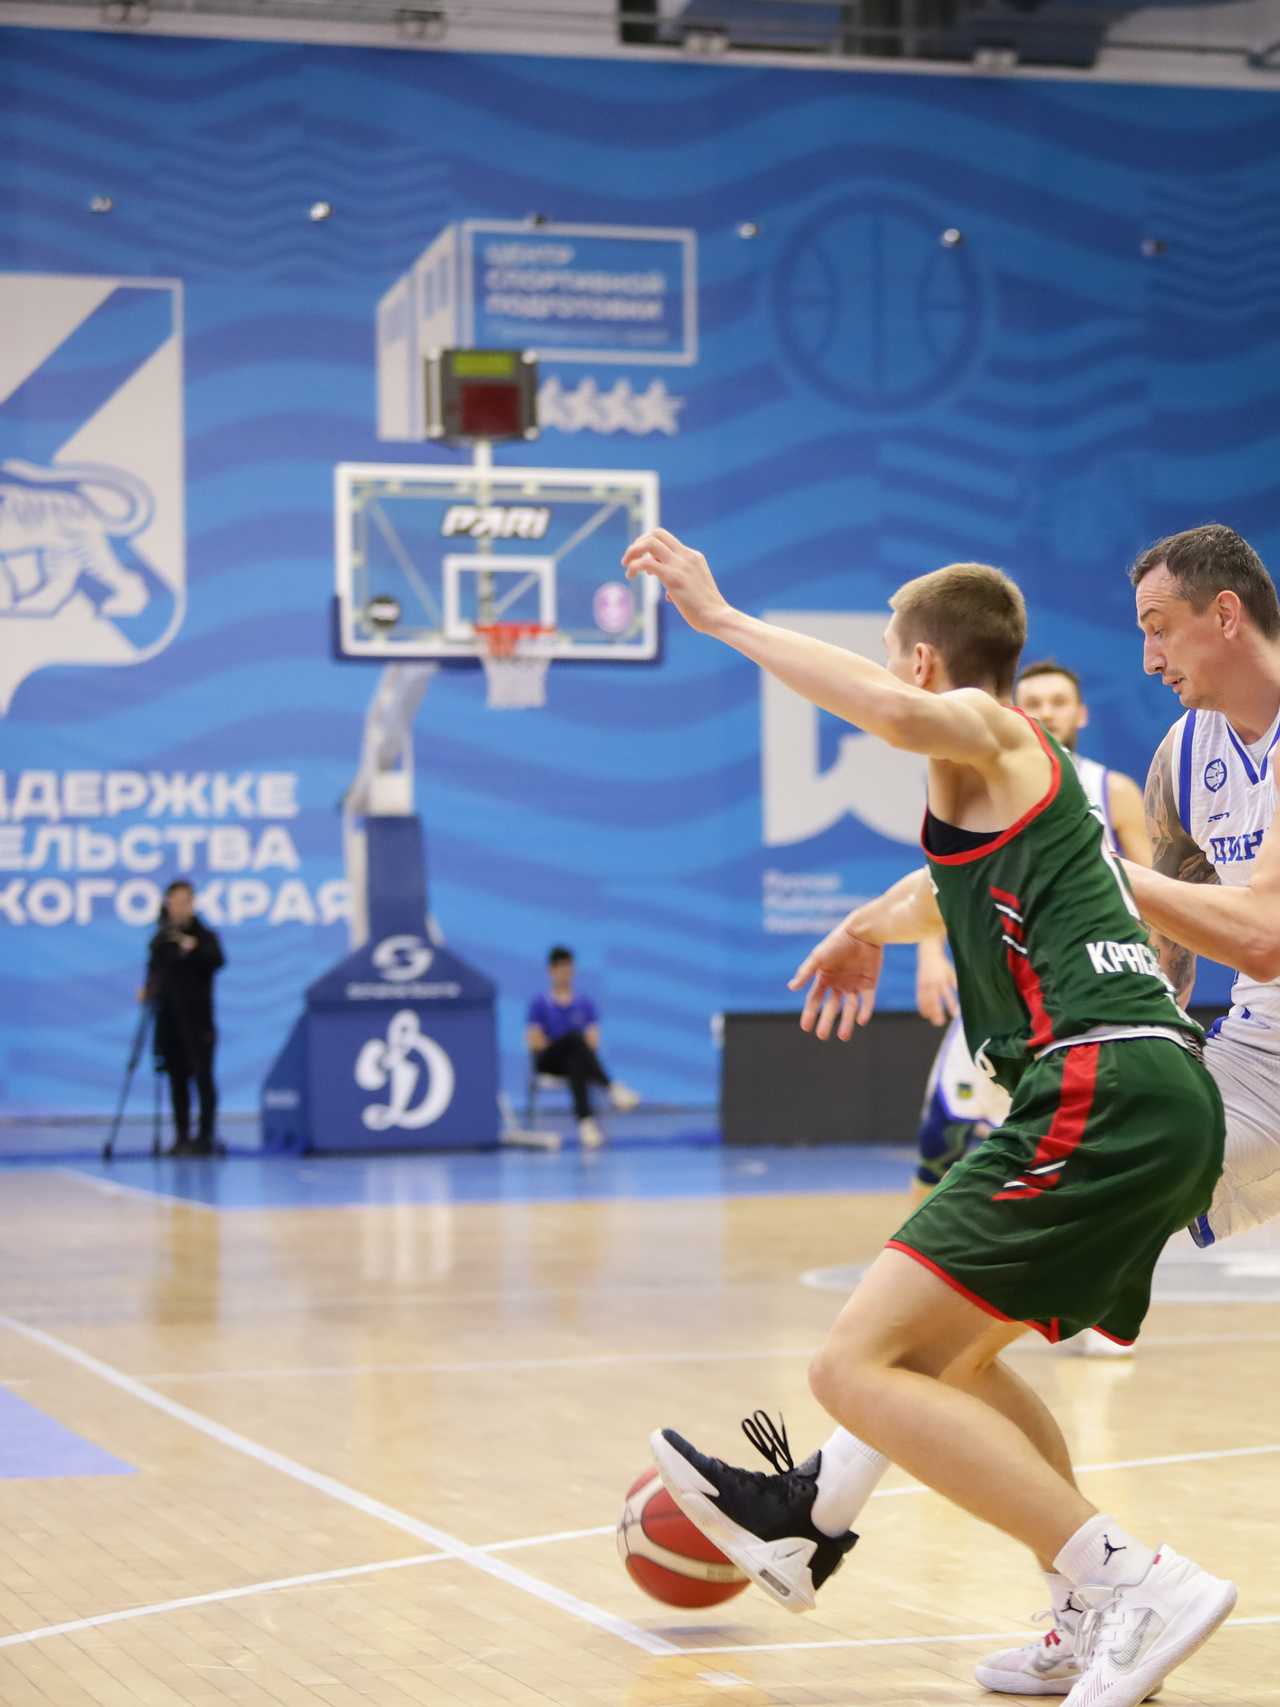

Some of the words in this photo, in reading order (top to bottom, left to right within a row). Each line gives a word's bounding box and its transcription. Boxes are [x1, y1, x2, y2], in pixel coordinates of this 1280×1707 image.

[441, 505, 551, 539] PARI
[0, 770, 298, 822] ДЕРЖКЕ
[1209, 829, 1268, 864] ДИН
